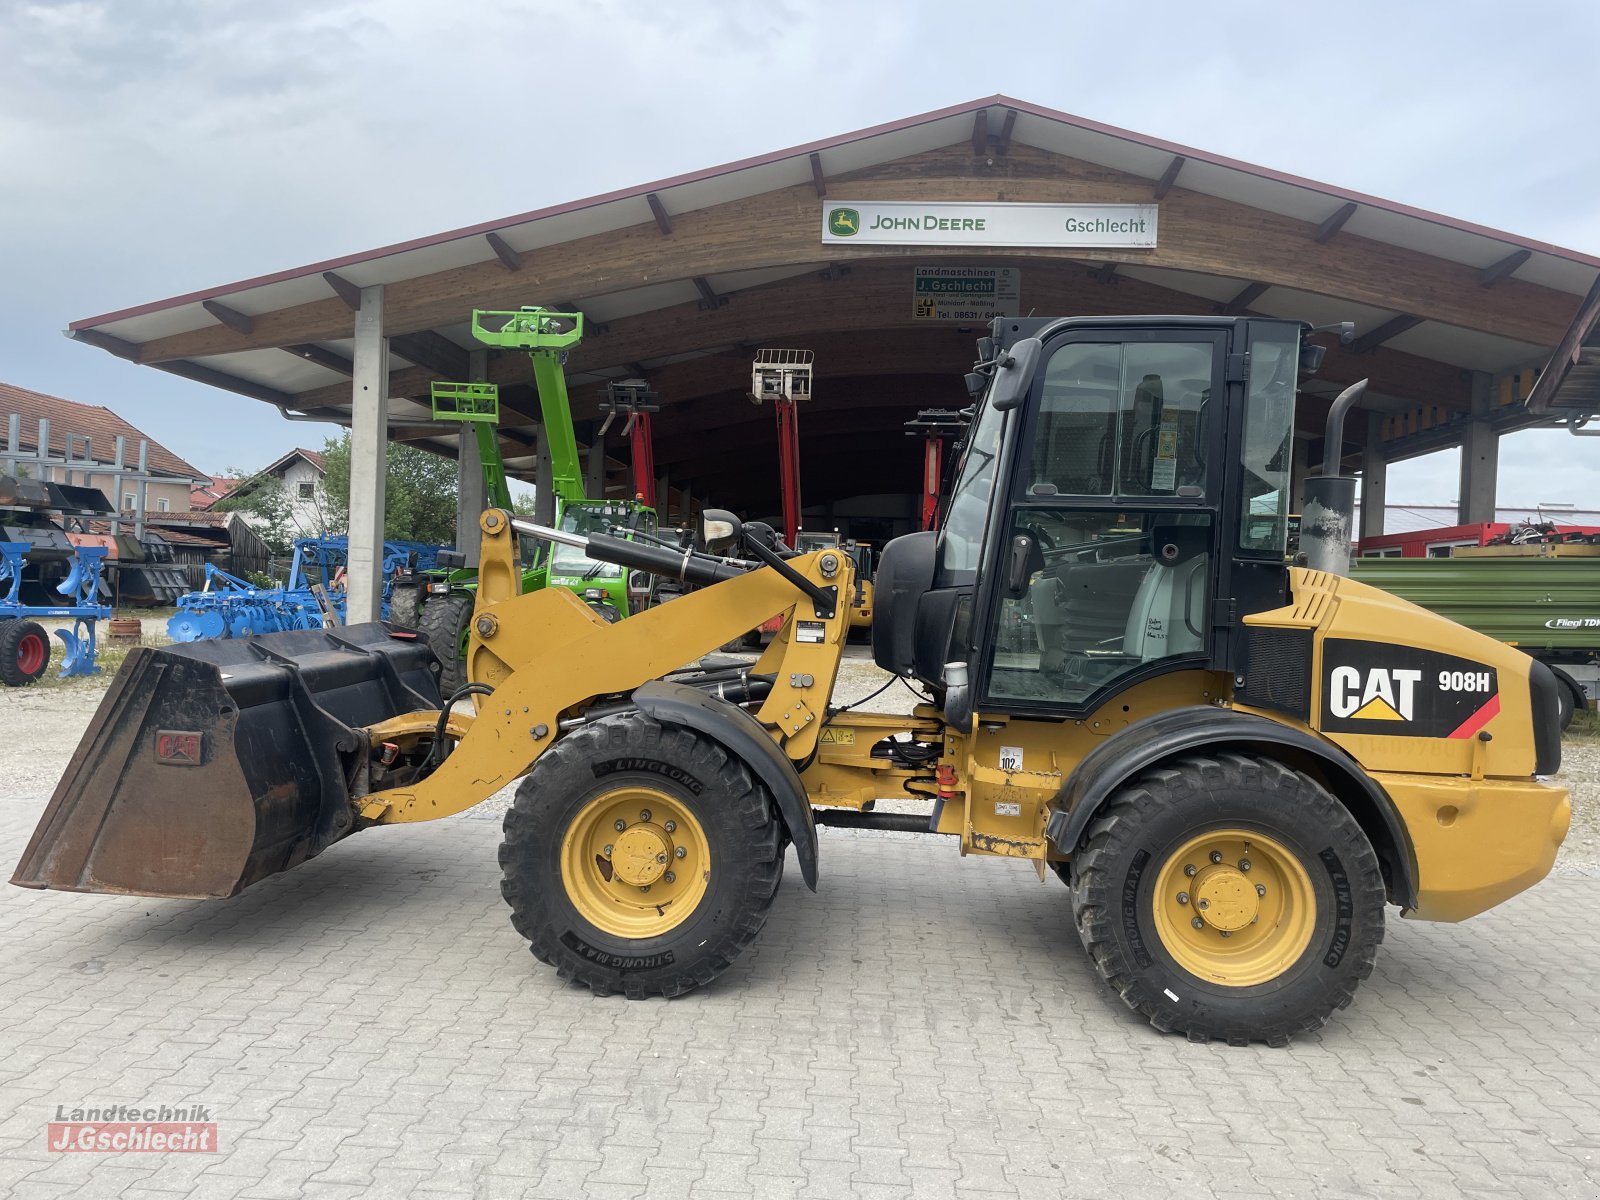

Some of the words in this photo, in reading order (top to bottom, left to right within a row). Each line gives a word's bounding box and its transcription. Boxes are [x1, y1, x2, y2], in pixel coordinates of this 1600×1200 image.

[870, 214, 920, 230] JOHN
[924, 215, 986, 231] DEERE
[1065, 218, 1146, 233] Gschlecht
[916, 267, 996, 277] Landmaschinen
[918, 280, 928, 291] J.
[932, 280, 993, 291] Gschlecht
[937, 311, 951, 319] Tel.
[1330, 666, 1421, 721] CAT
[1438, 671, 1490, 692] 908H
[159, 735, 198, 760] CAT
[1001, 757, 1015, 770] 102
